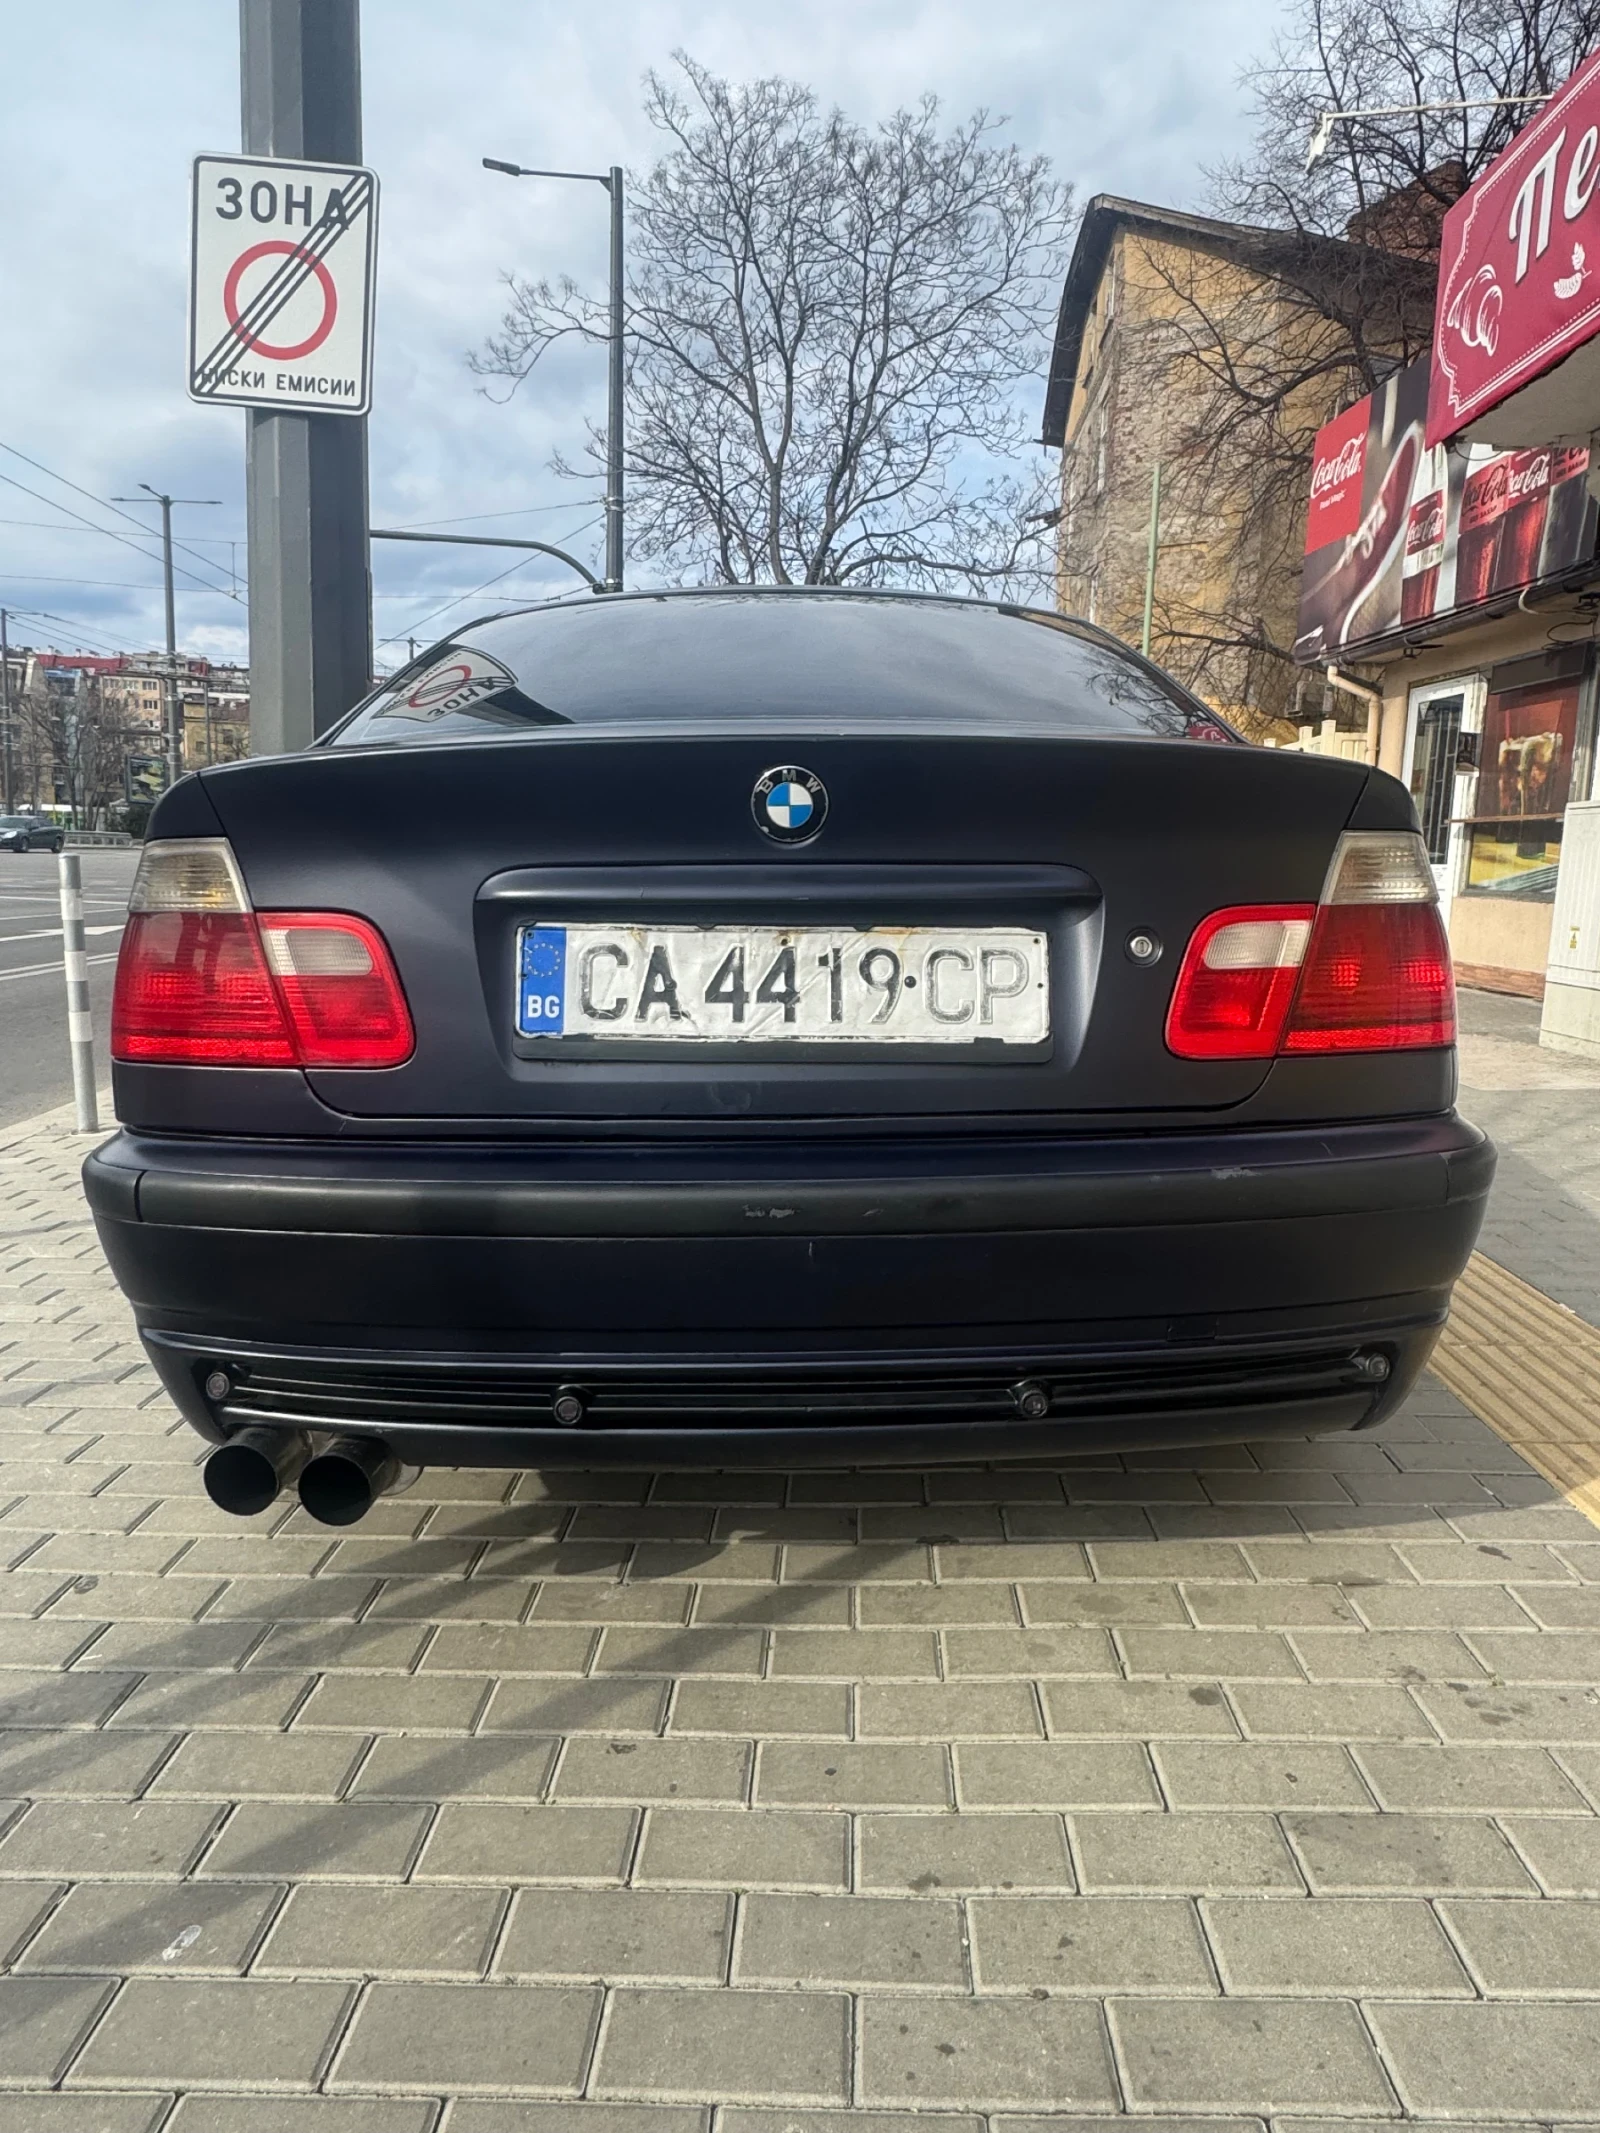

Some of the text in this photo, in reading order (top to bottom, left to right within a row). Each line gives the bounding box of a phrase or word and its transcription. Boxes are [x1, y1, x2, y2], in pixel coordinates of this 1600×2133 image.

[216, 177, 349, 230] ЗОНА
[1508, 125, 1600, 284] Пе
[276, 374, 356, 397] ЕМИСИИ
[755, 768, 821, 794] BMW
[580, 943, 1029, 1025] CA 4419 CP
[527, 994, 560, 1018] BG
